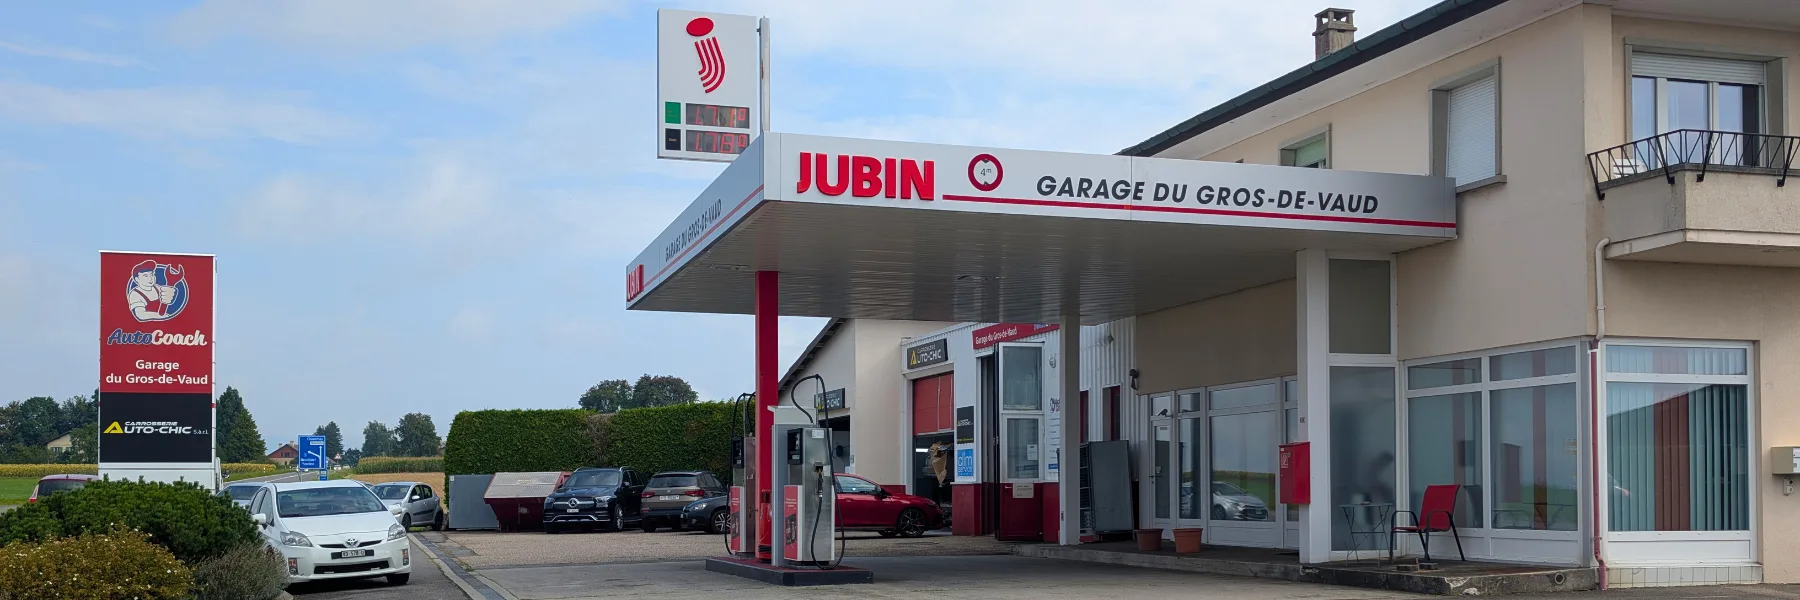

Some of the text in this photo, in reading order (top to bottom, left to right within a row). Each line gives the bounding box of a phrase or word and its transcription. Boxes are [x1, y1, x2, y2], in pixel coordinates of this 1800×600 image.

[796, 151, 935, 201] JUBIN
[1036, 175, 1379, 214] GARAGE DU GROS-DE-VAUD
[626, 264, 644, 302] UBIN
[107, 328, 207, 345] AutoCoach
[135, 360, 180, 372] Garage
[106, 373, 208, 385] du Gros-de-Vaud
[103, 420, 192, 434] AUTO-CHIC
